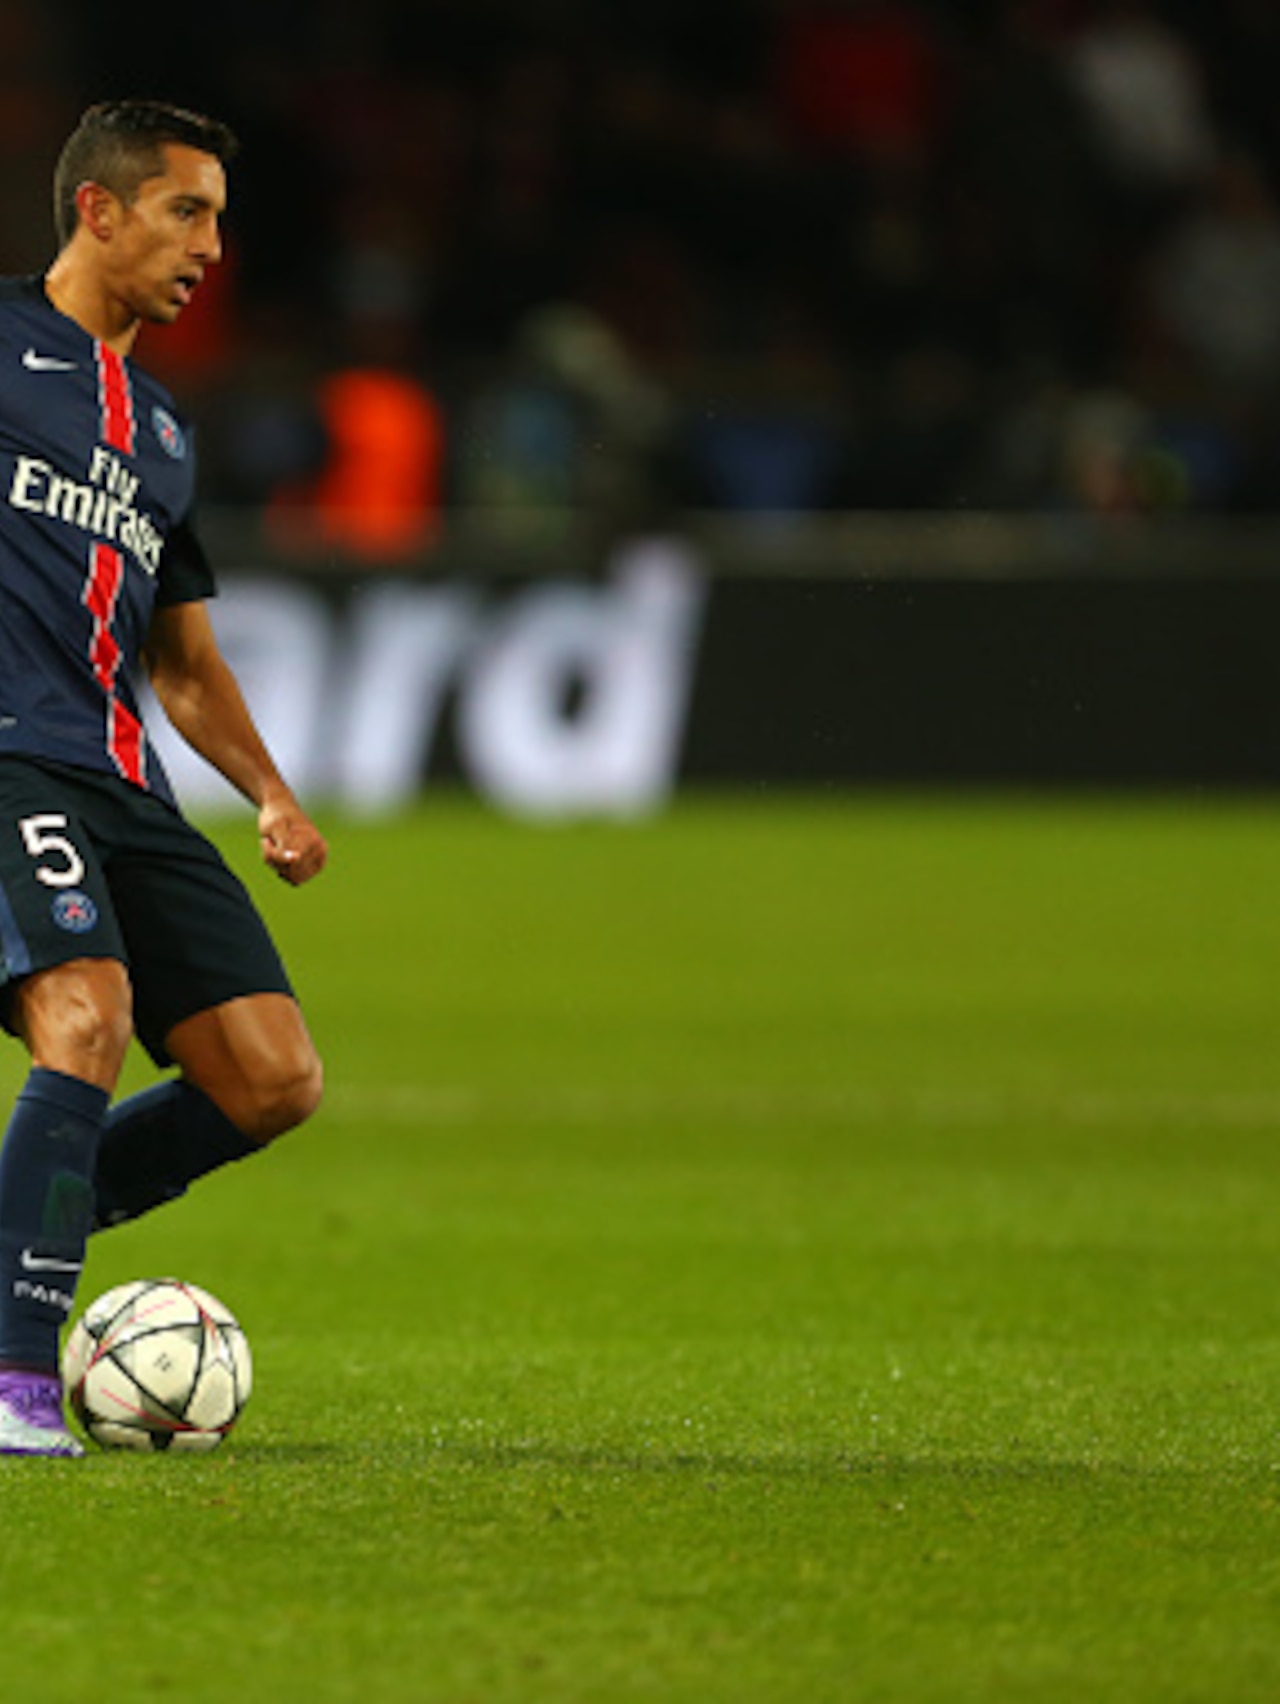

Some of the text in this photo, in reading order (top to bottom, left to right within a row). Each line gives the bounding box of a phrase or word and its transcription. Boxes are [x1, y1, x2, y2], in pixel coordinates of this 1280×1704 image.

[88, 445, 141, 505] Fly
[8, 454, 165, 576] Emirates
[20, 814, 85, 887] 5
